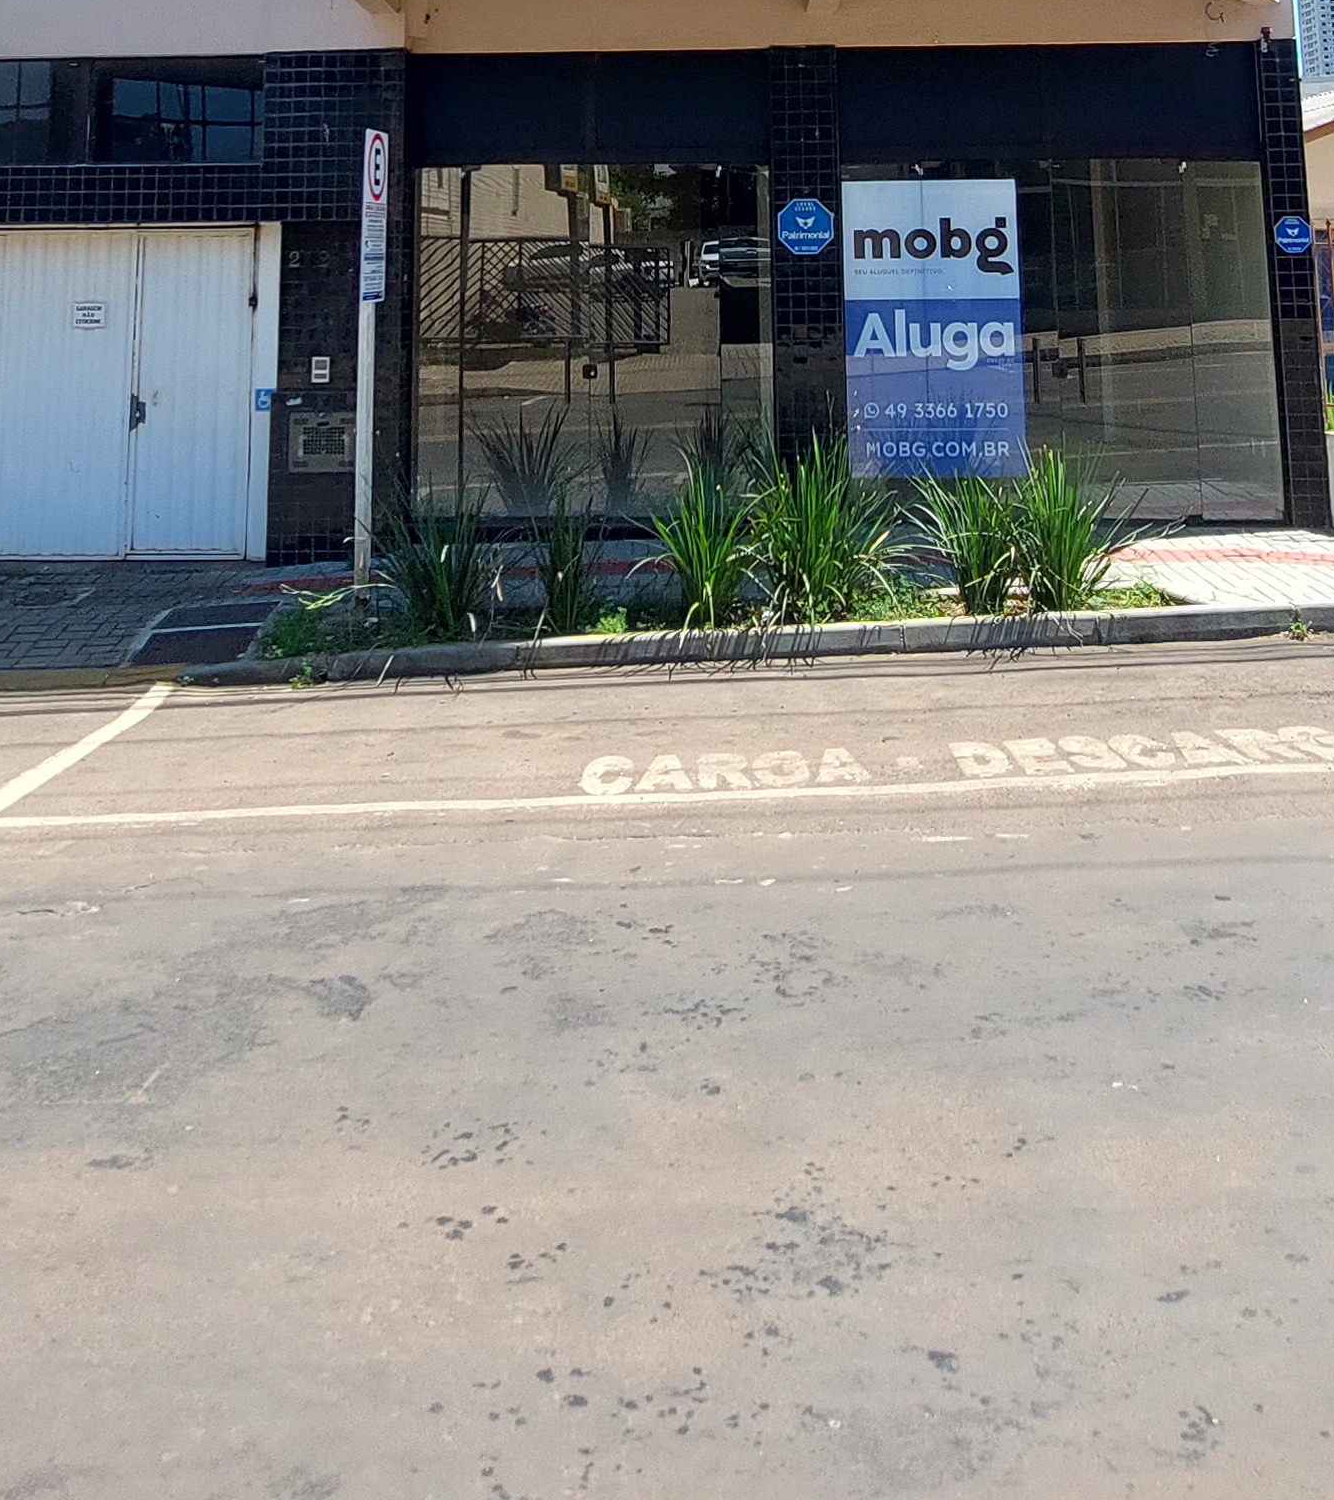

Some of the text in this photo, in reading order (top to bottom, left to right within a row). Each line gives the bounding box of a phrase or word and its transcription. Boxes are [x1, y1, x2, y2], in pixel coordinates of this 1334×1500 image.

[374, 147, 381, 186] E
[782, 230, 830, 239] Patrimonial
[853, 216, 1014, 276] mobg
[853, 308, 1015, 371] Aluga
[884, 402, 1008, 419] 49 3366 1750
[577, 747, 873, 796] CARGA
